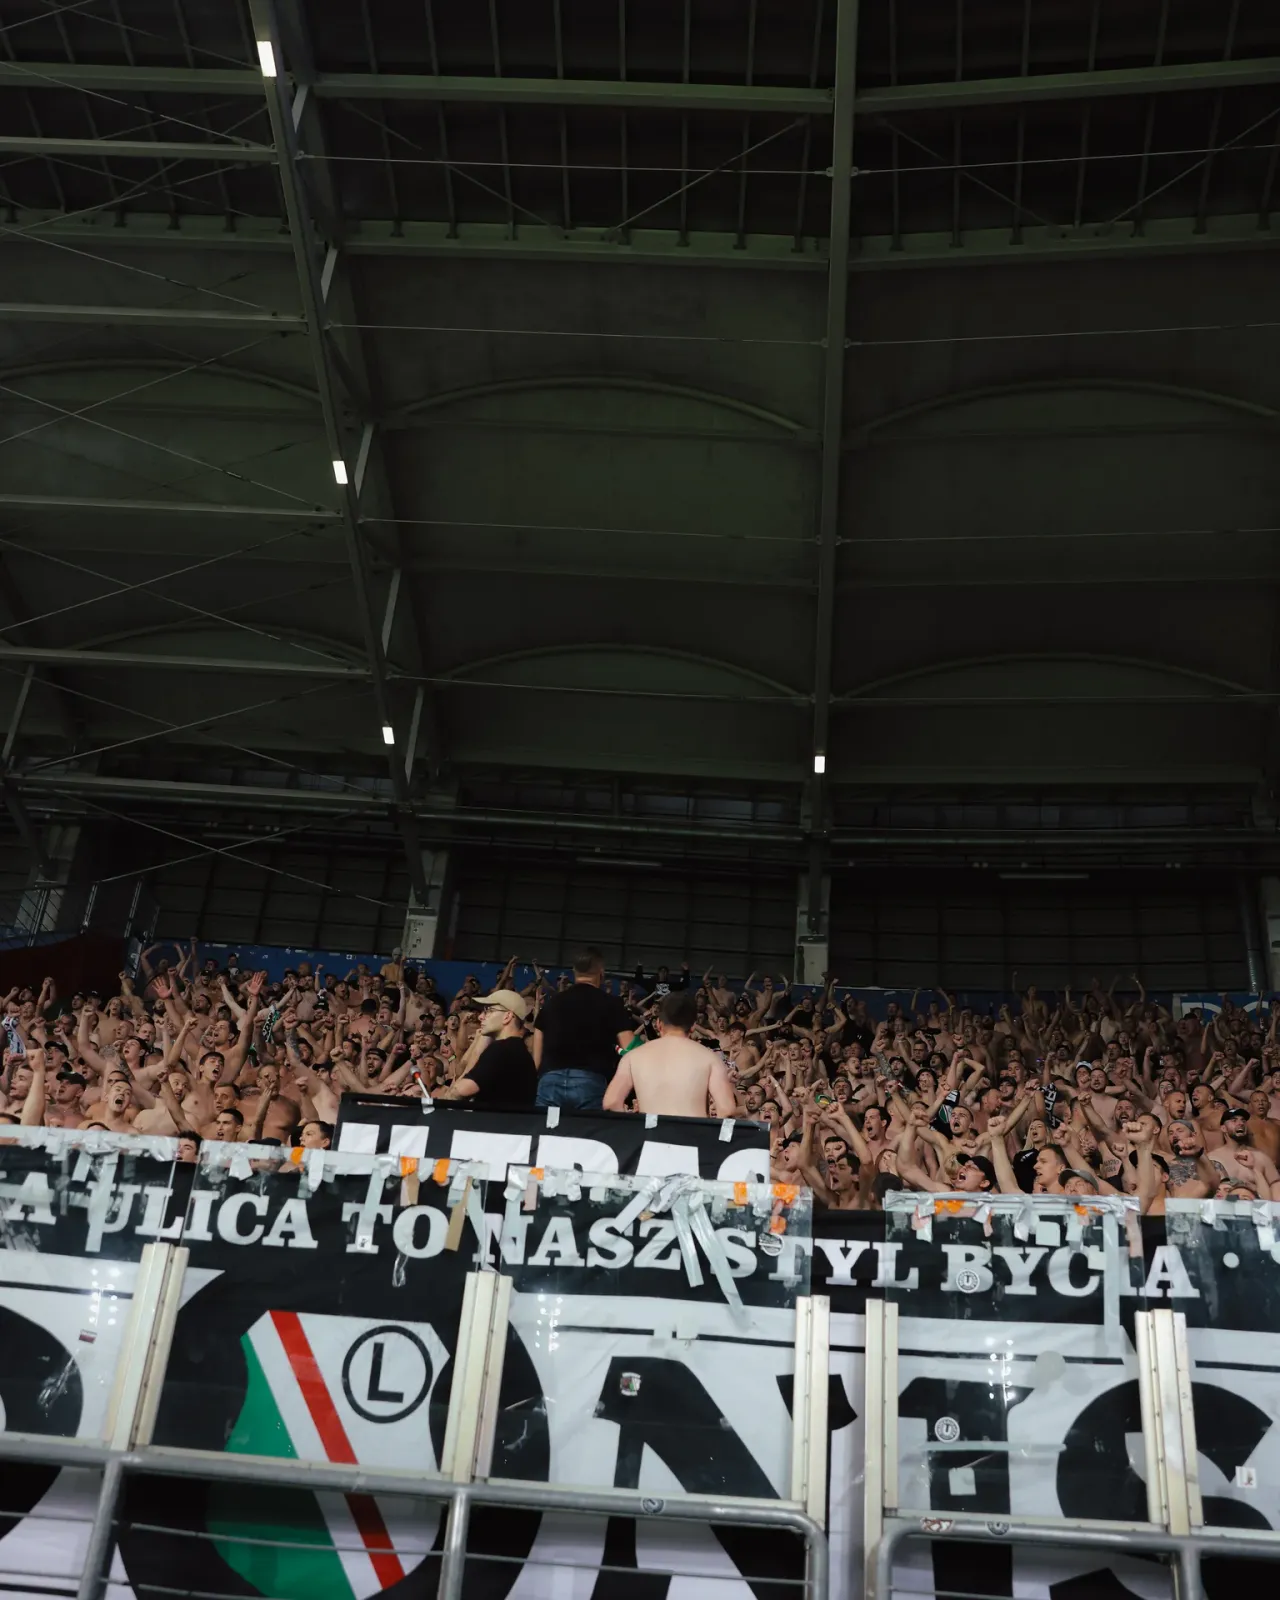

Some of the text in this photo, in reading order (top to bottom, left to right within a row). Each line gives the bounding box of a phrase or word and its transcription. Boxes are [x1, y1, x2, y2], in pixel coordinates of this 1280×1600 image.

[86, 1180, 318, 1248] ULICA
[341, 1202, 449, 1259] TO
[472, 1213, 681, 1270] NASZ
[710, 1227, 919, 1289] STYL
[366, 1342, 404, 1403] L
